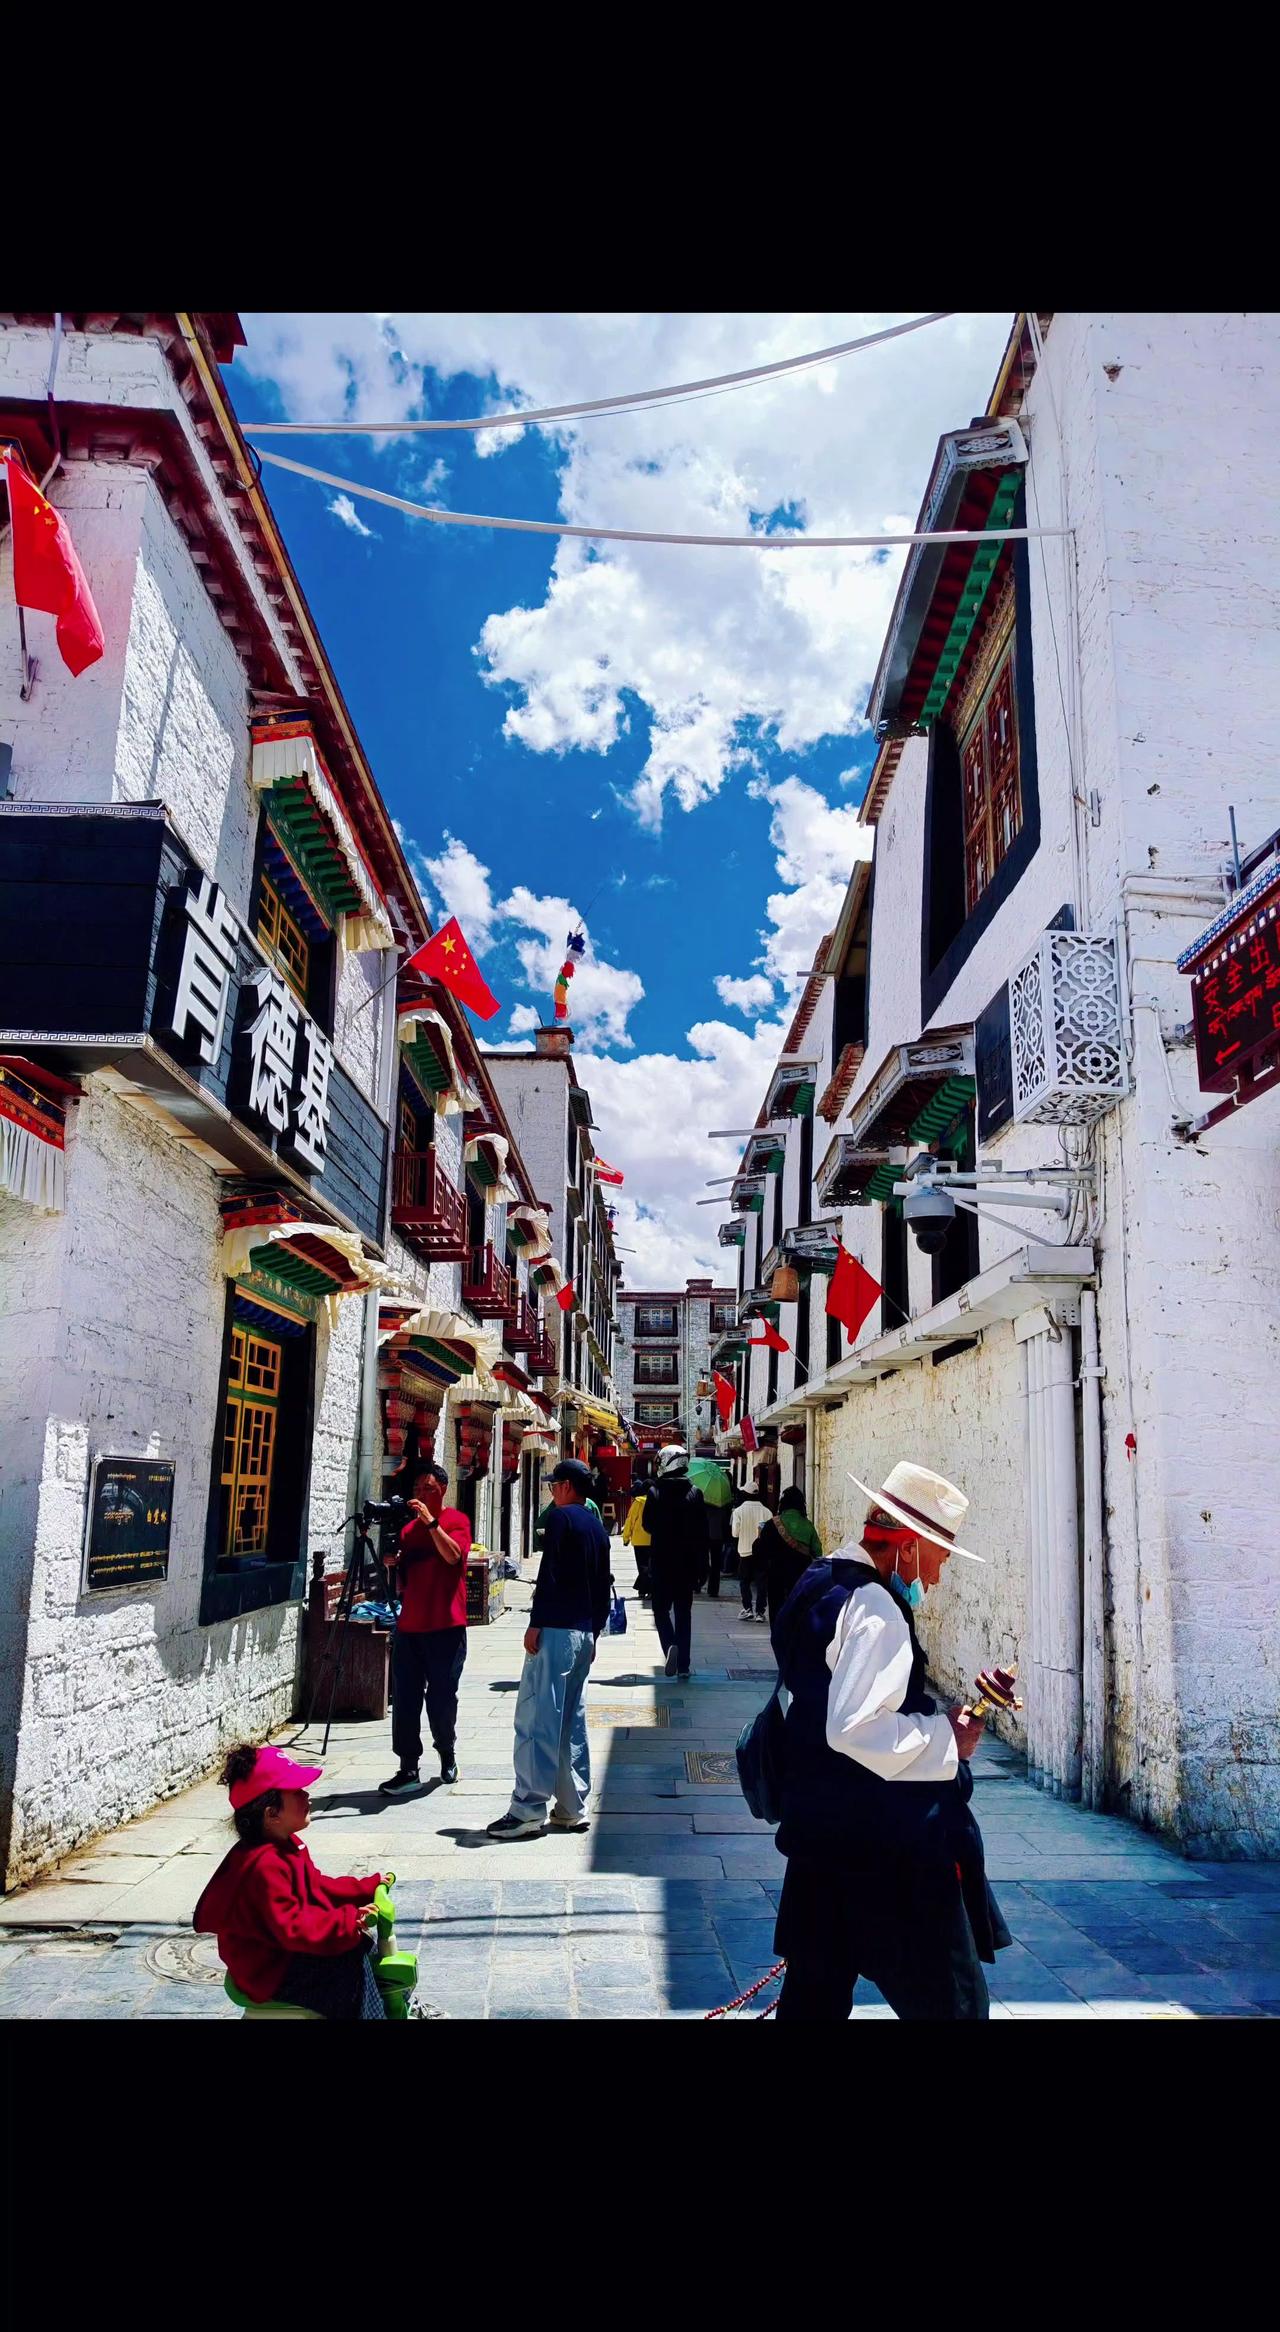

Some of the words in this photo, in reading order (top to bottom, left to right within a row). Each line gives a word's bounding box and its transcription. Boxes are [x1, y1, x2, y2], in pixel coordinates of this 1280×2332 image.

[171, 880, 335, 1175] 肯德基
[1203, 921, 1280, 1015] 安全出
